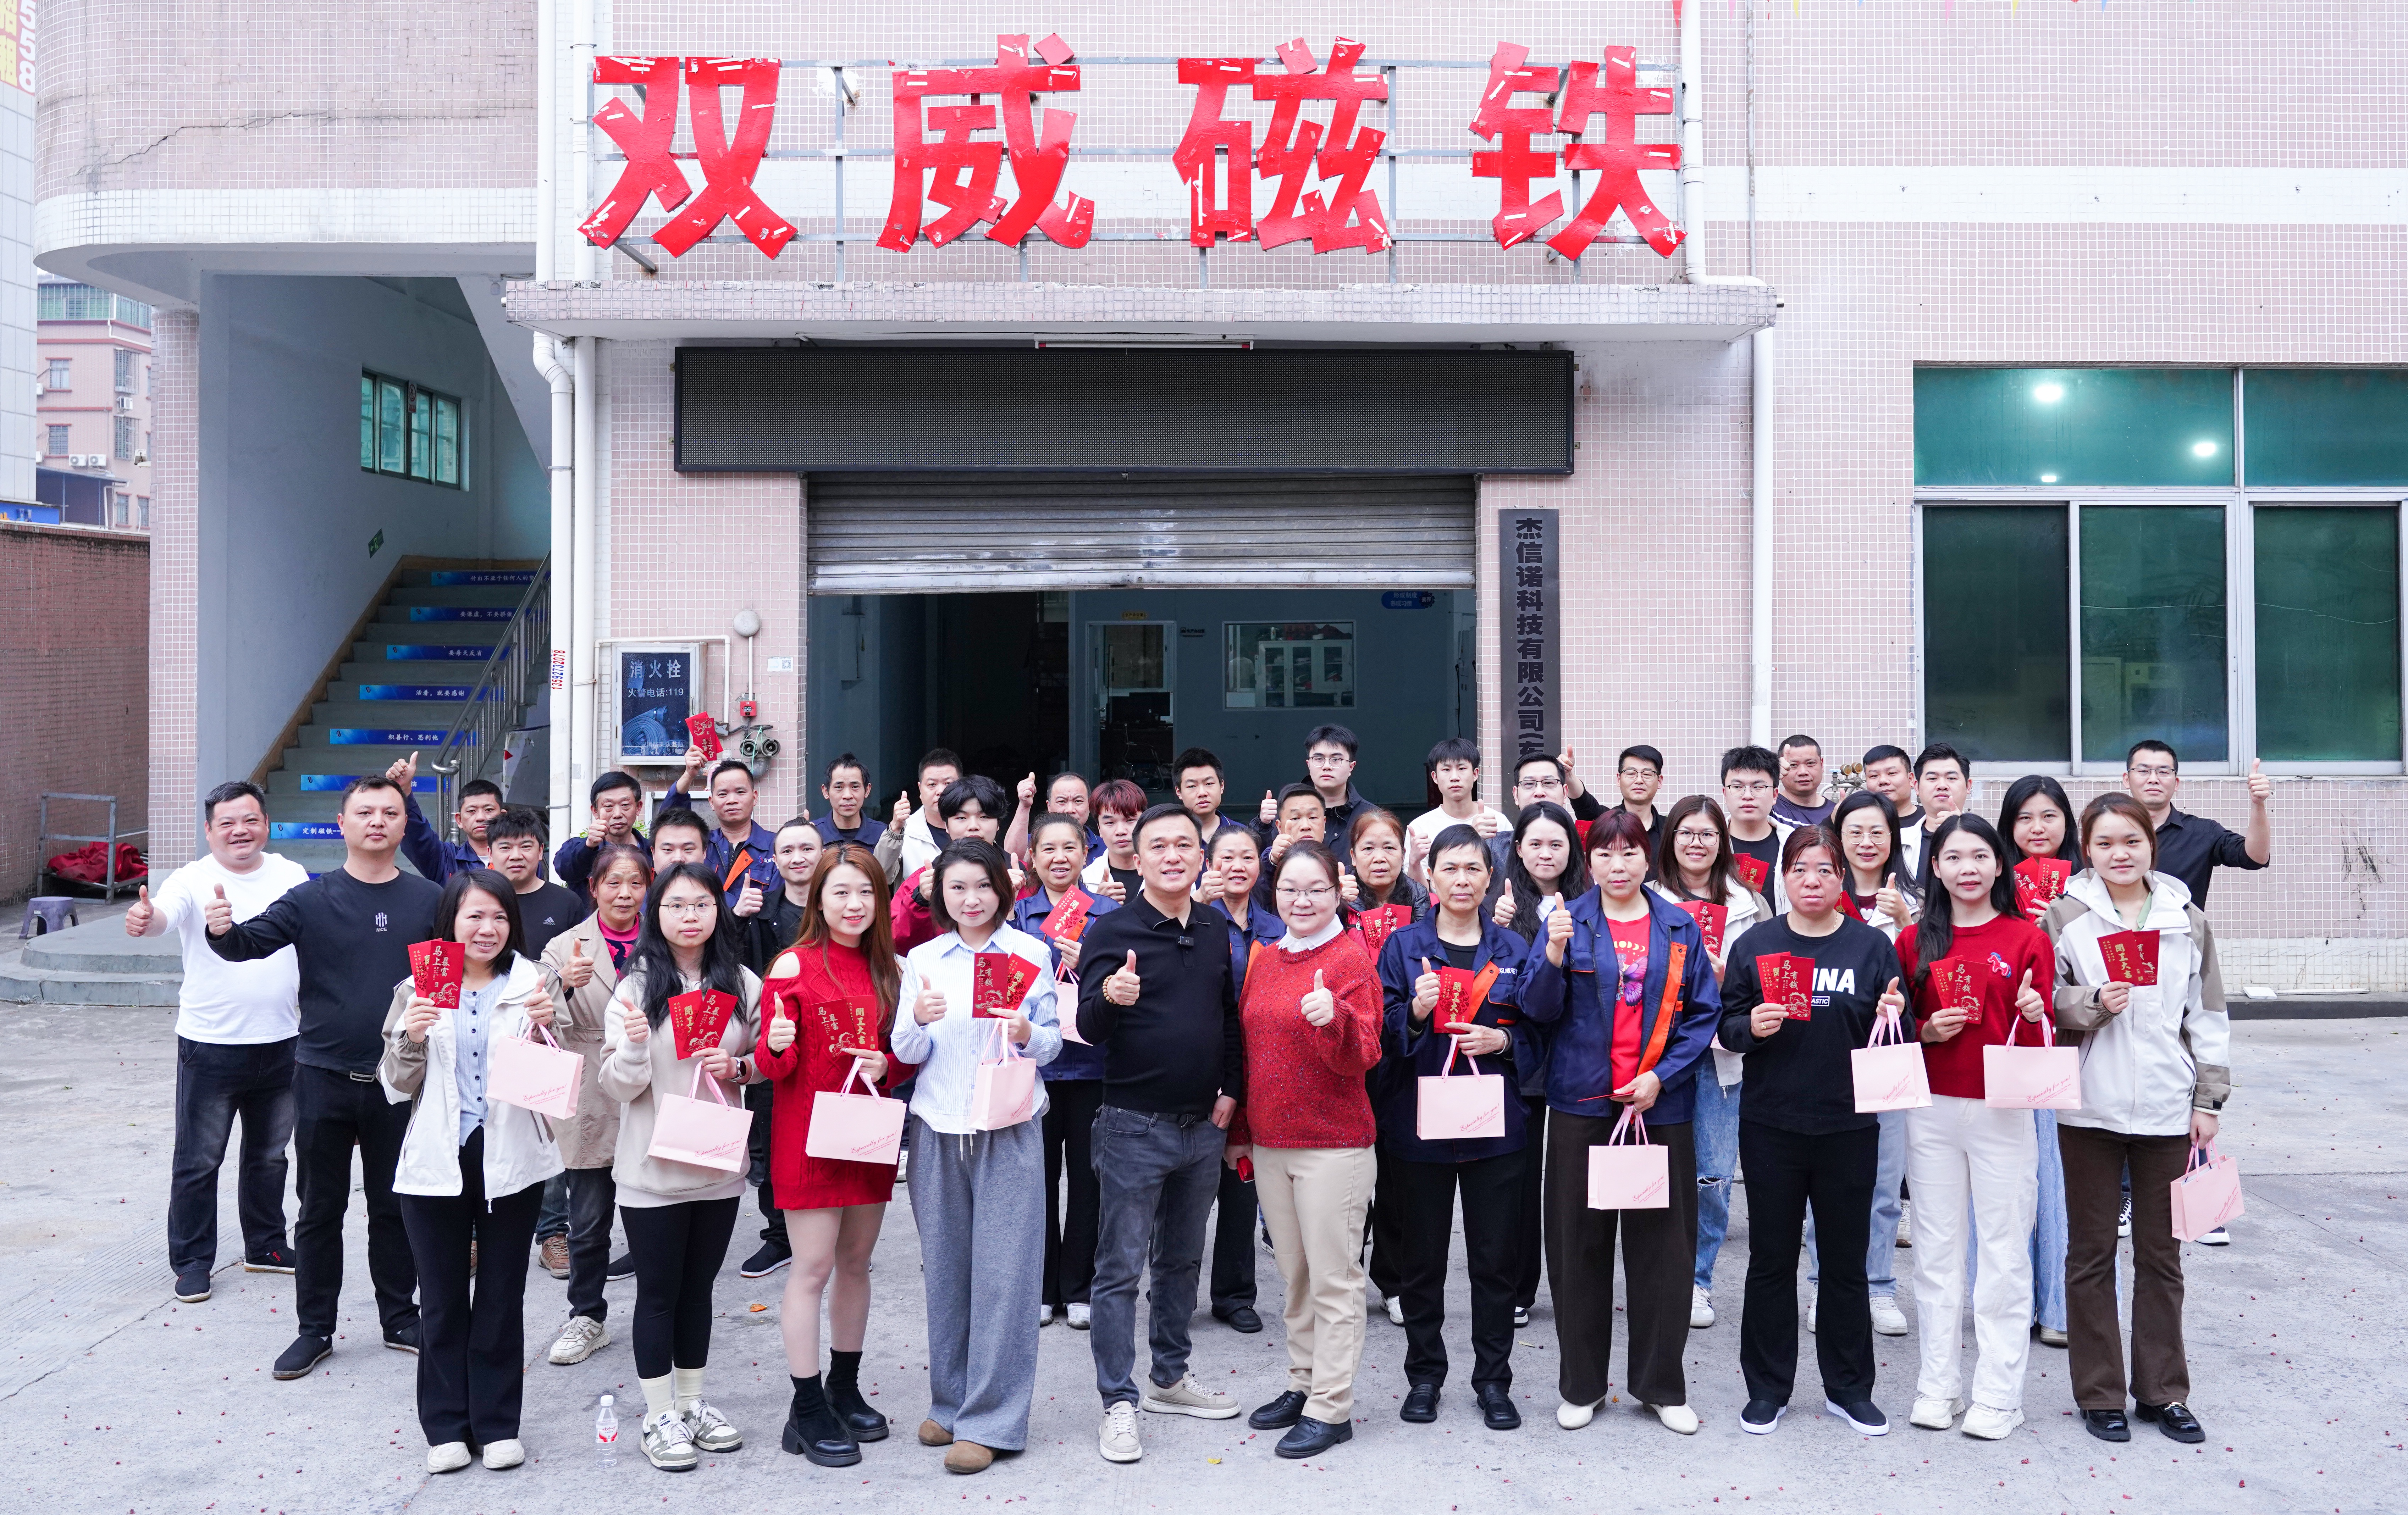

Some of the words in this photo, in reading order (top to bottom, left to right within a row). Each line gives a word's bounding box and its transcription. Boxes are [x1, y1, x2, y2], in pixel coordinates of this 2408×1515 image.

[577, 34, 1686, 260] 双威磁铁
[551, 650, 565, 689] 13592732078
[630, 659, 681, 678] 消火栓
[2049, 871, 2060, 902] 開工大
[432, 945, 442, 966] 马上
[2115, 943, 2132, 978] 開工大吉
[441, 957, 450, 977] 暴富
[976, 957, 986, 977] 马上
[984, 967, 993, 987] 有钱
[1782, 960, 1791, 979] 马上
[1955, 964, 1965, 982] 马上
[1789, 971, 1798, 990] 有钱
[1962, 975, 1972, 994] 有钱
[703, 995, 716, 1014] 马上
[1450, 982, 1462, 1022] 開工大吉
[708, 1007, 720, 1025] 暴富
[818, 1006, 830, 1024] 马上
[829, 1014, 839, 1030] 暴富
[856, 1008, 866, 1044] 開工大吉
